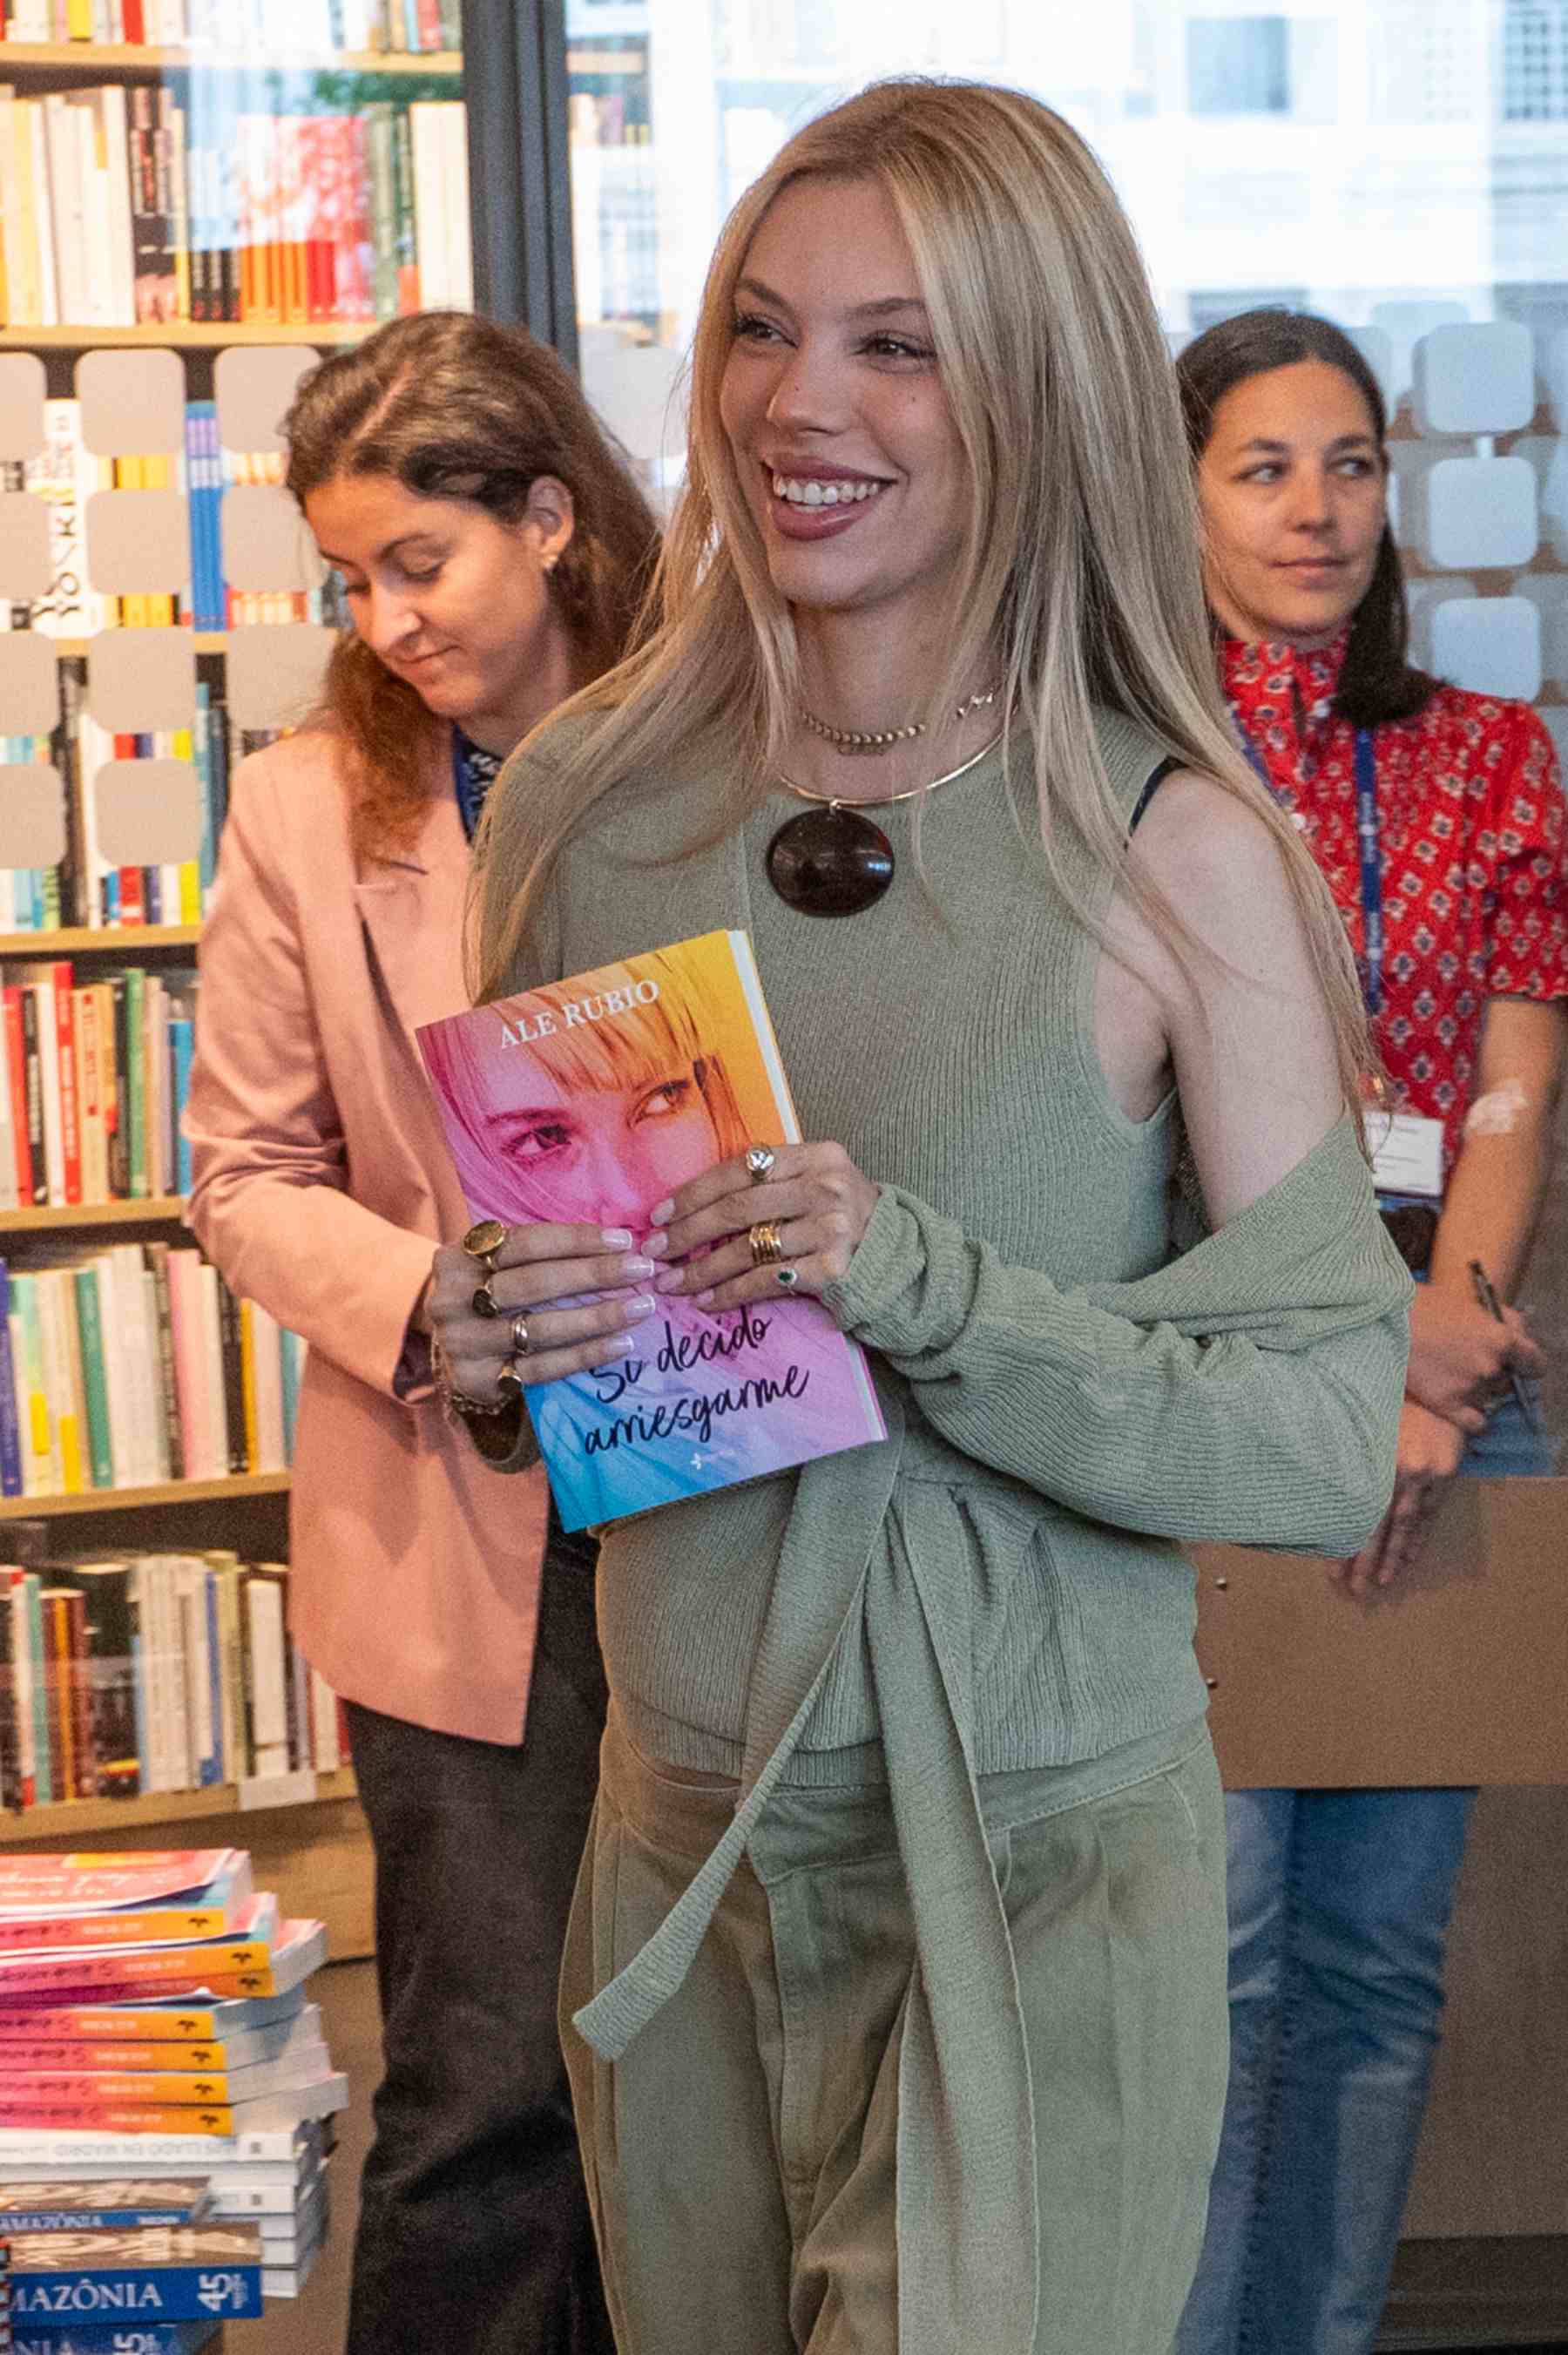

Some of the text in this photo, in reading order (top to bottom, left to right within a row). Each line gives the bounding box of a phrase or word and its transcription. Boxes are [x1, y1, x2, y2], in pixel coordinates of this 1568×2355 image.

[501, 978, 660, 1050] ALE RUBIO
[657, 1304, 772, 1372] decido
[585, 1364, 810, 1454] arriesgarme
